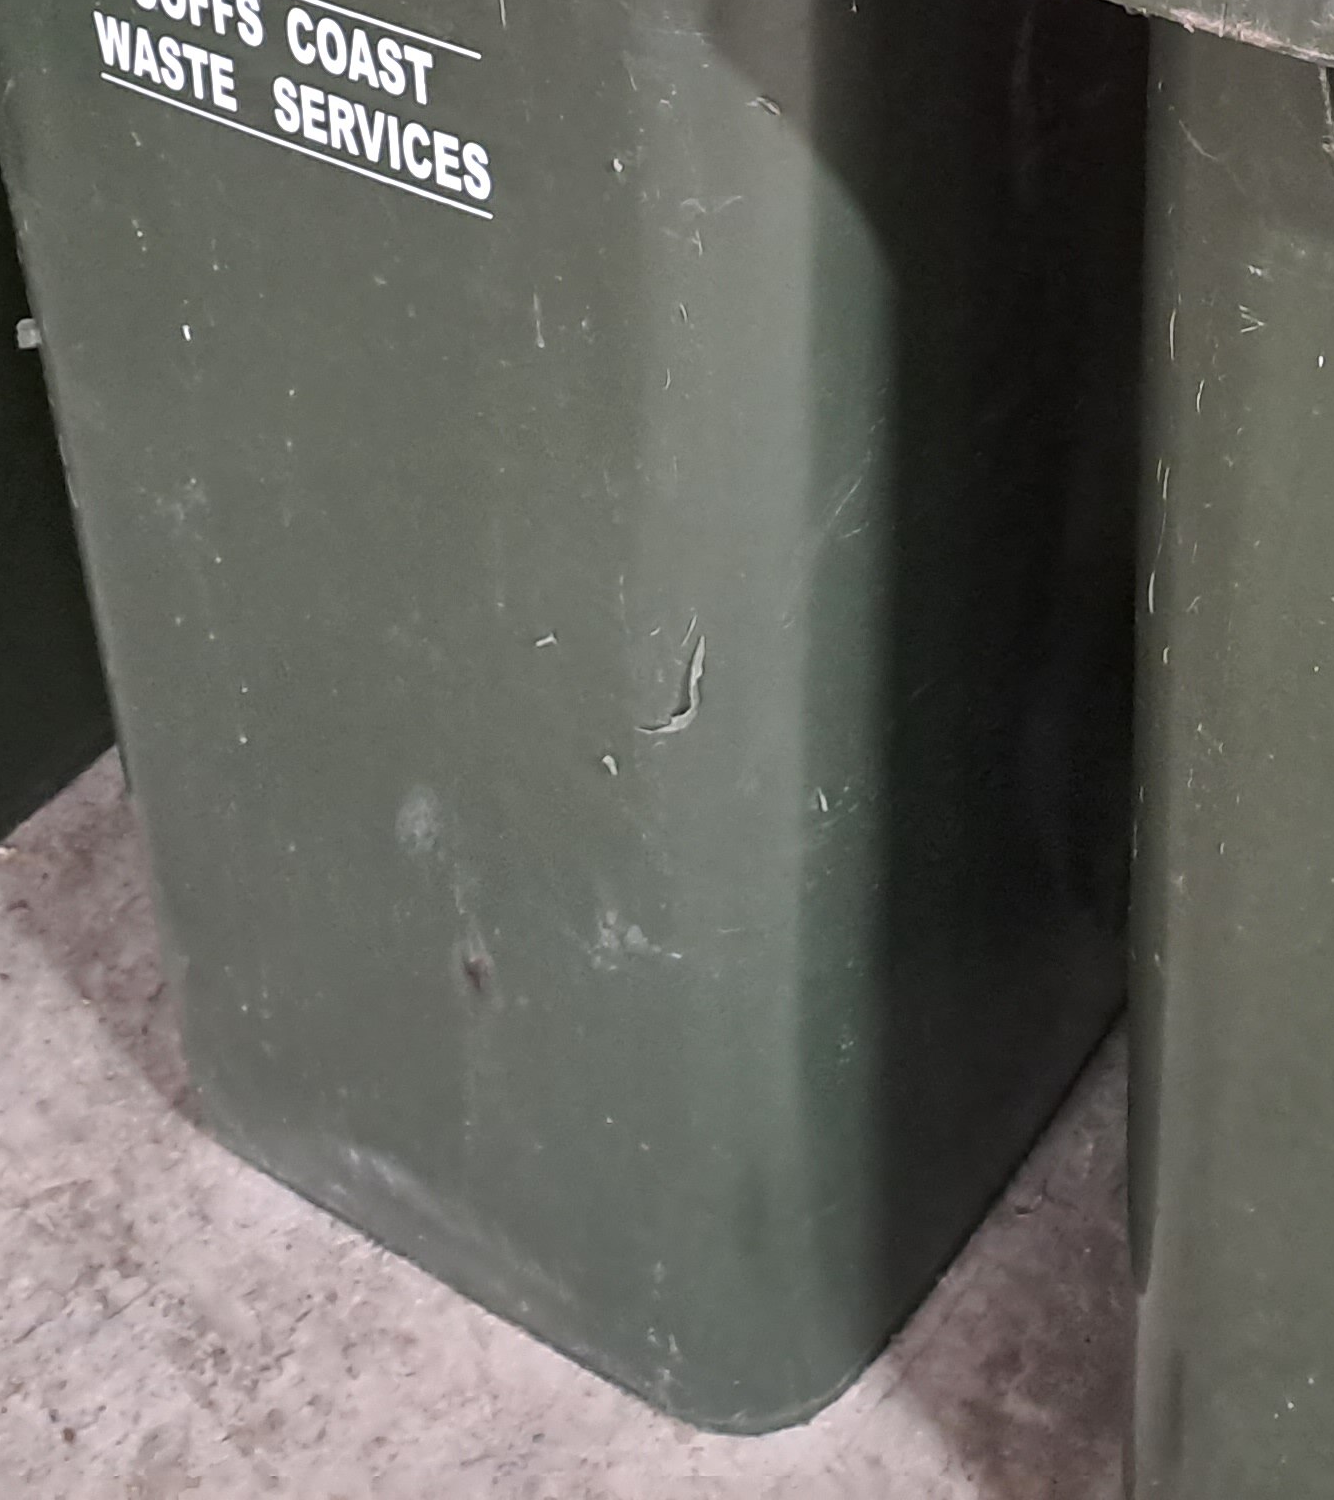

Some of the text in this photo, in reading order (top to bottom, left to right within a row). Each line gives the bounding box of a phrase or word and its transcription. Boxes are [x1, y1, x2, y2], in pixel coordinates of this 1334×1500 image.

[93, 11, 492, 200] WASTE SERVICES
[286, 7, 434, 105] COAST
